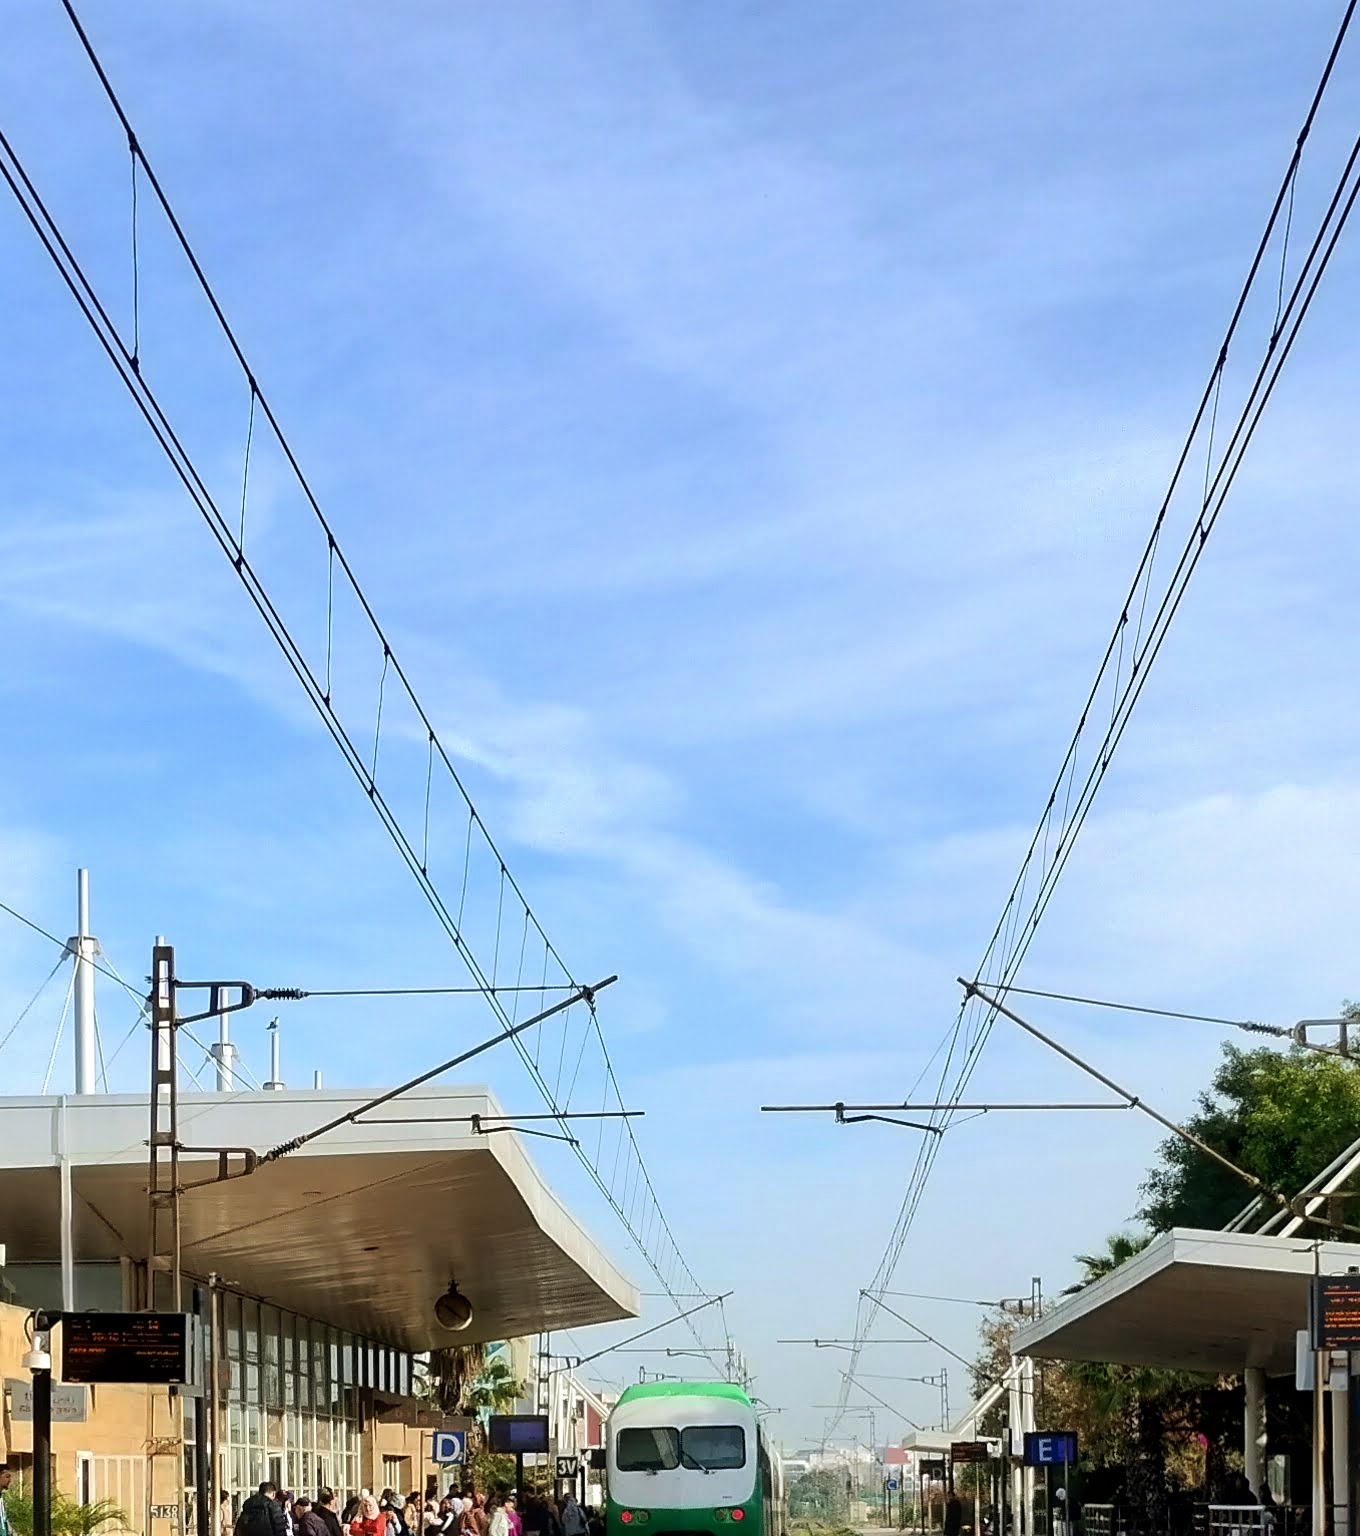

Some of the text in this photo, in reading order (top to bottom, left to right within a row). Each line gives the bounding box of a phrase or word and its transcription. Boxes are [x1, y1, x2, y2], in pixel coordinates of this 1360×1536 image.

[1038, 1438, 1052, 1461] E
[558, 1459, 576, 1475] 3V
[150, 1505, 178, 1518] 5138
